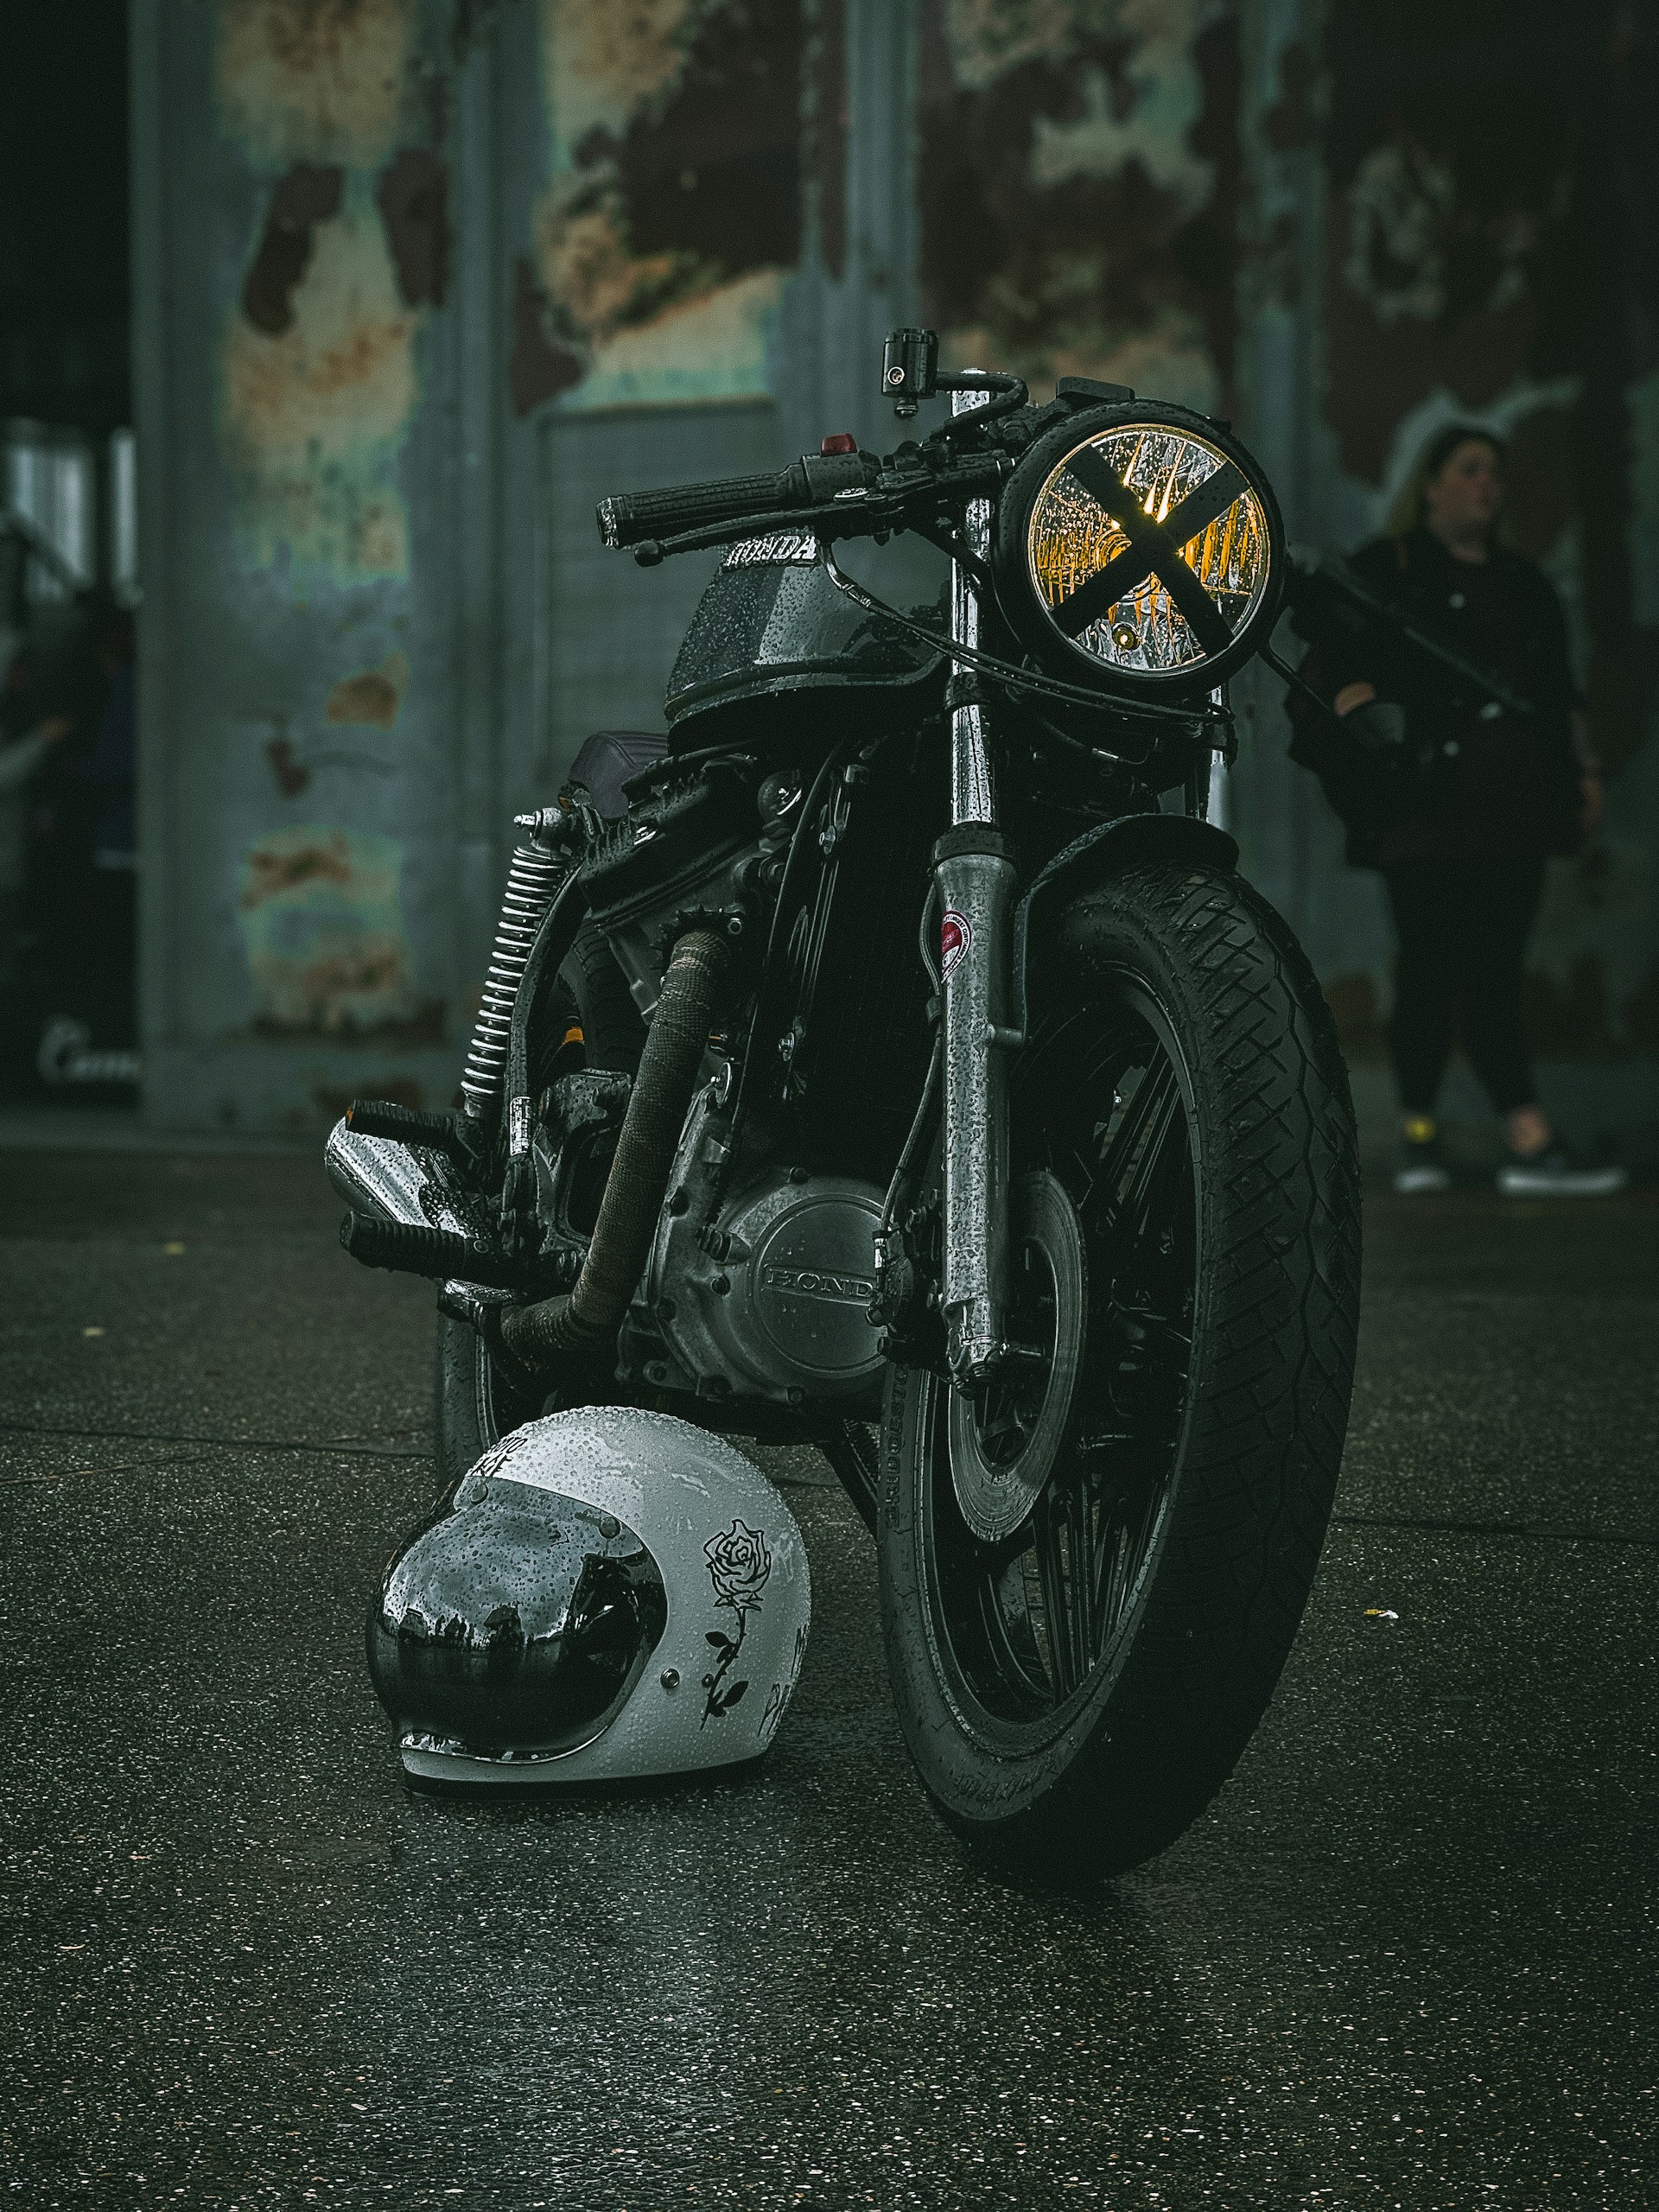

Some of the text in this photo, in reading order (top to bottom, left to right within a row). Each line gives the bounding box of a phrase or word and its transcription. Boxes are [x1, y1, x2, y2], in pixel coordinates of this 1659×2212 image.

[723, 535, 817, 566] HONDA
[767, 1267, 875, 1298] HOND
[885, 1364, 907, 1531] BRIDGESTO
